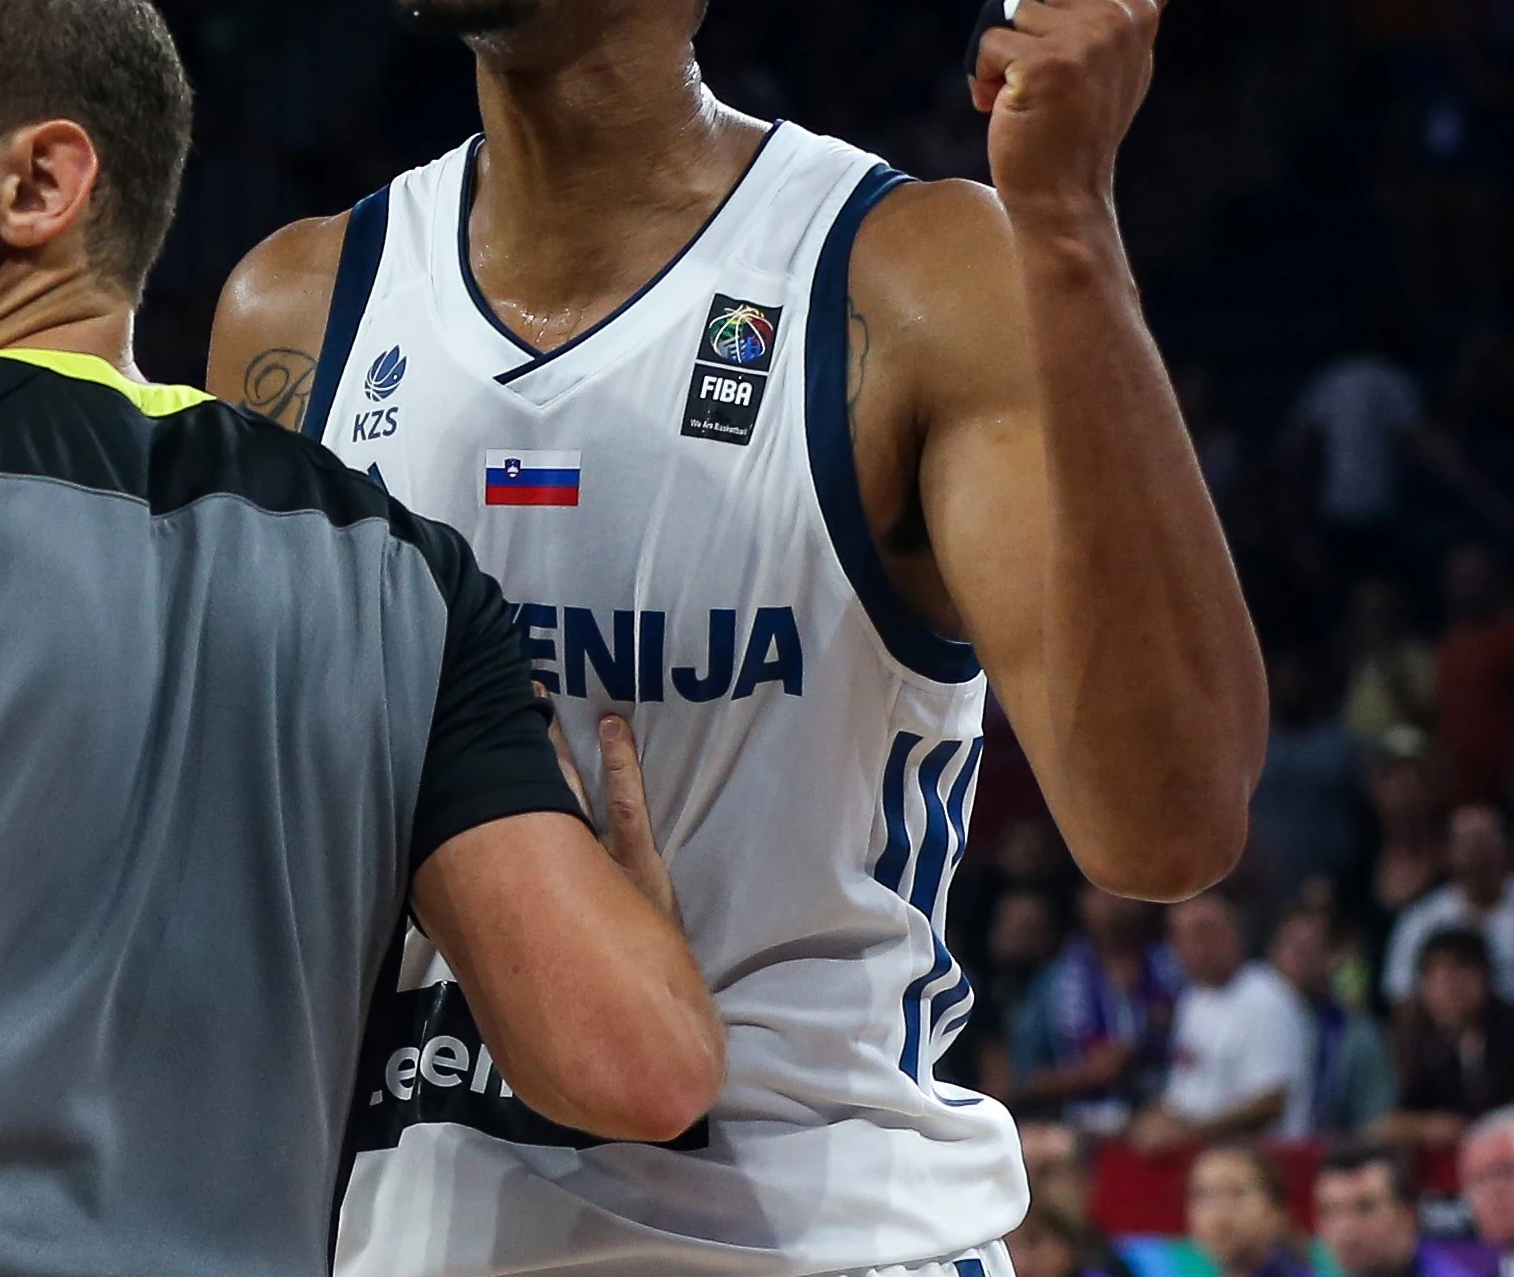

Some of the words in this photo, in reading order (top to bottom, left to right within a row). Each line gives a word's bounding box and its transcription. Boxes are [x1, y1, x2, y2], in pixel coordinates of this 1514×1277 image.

[699, 375, 753, 407] FIBA
[352, 406, 399, 443] KZS
[505, 603, 803, 703] ENIJA
